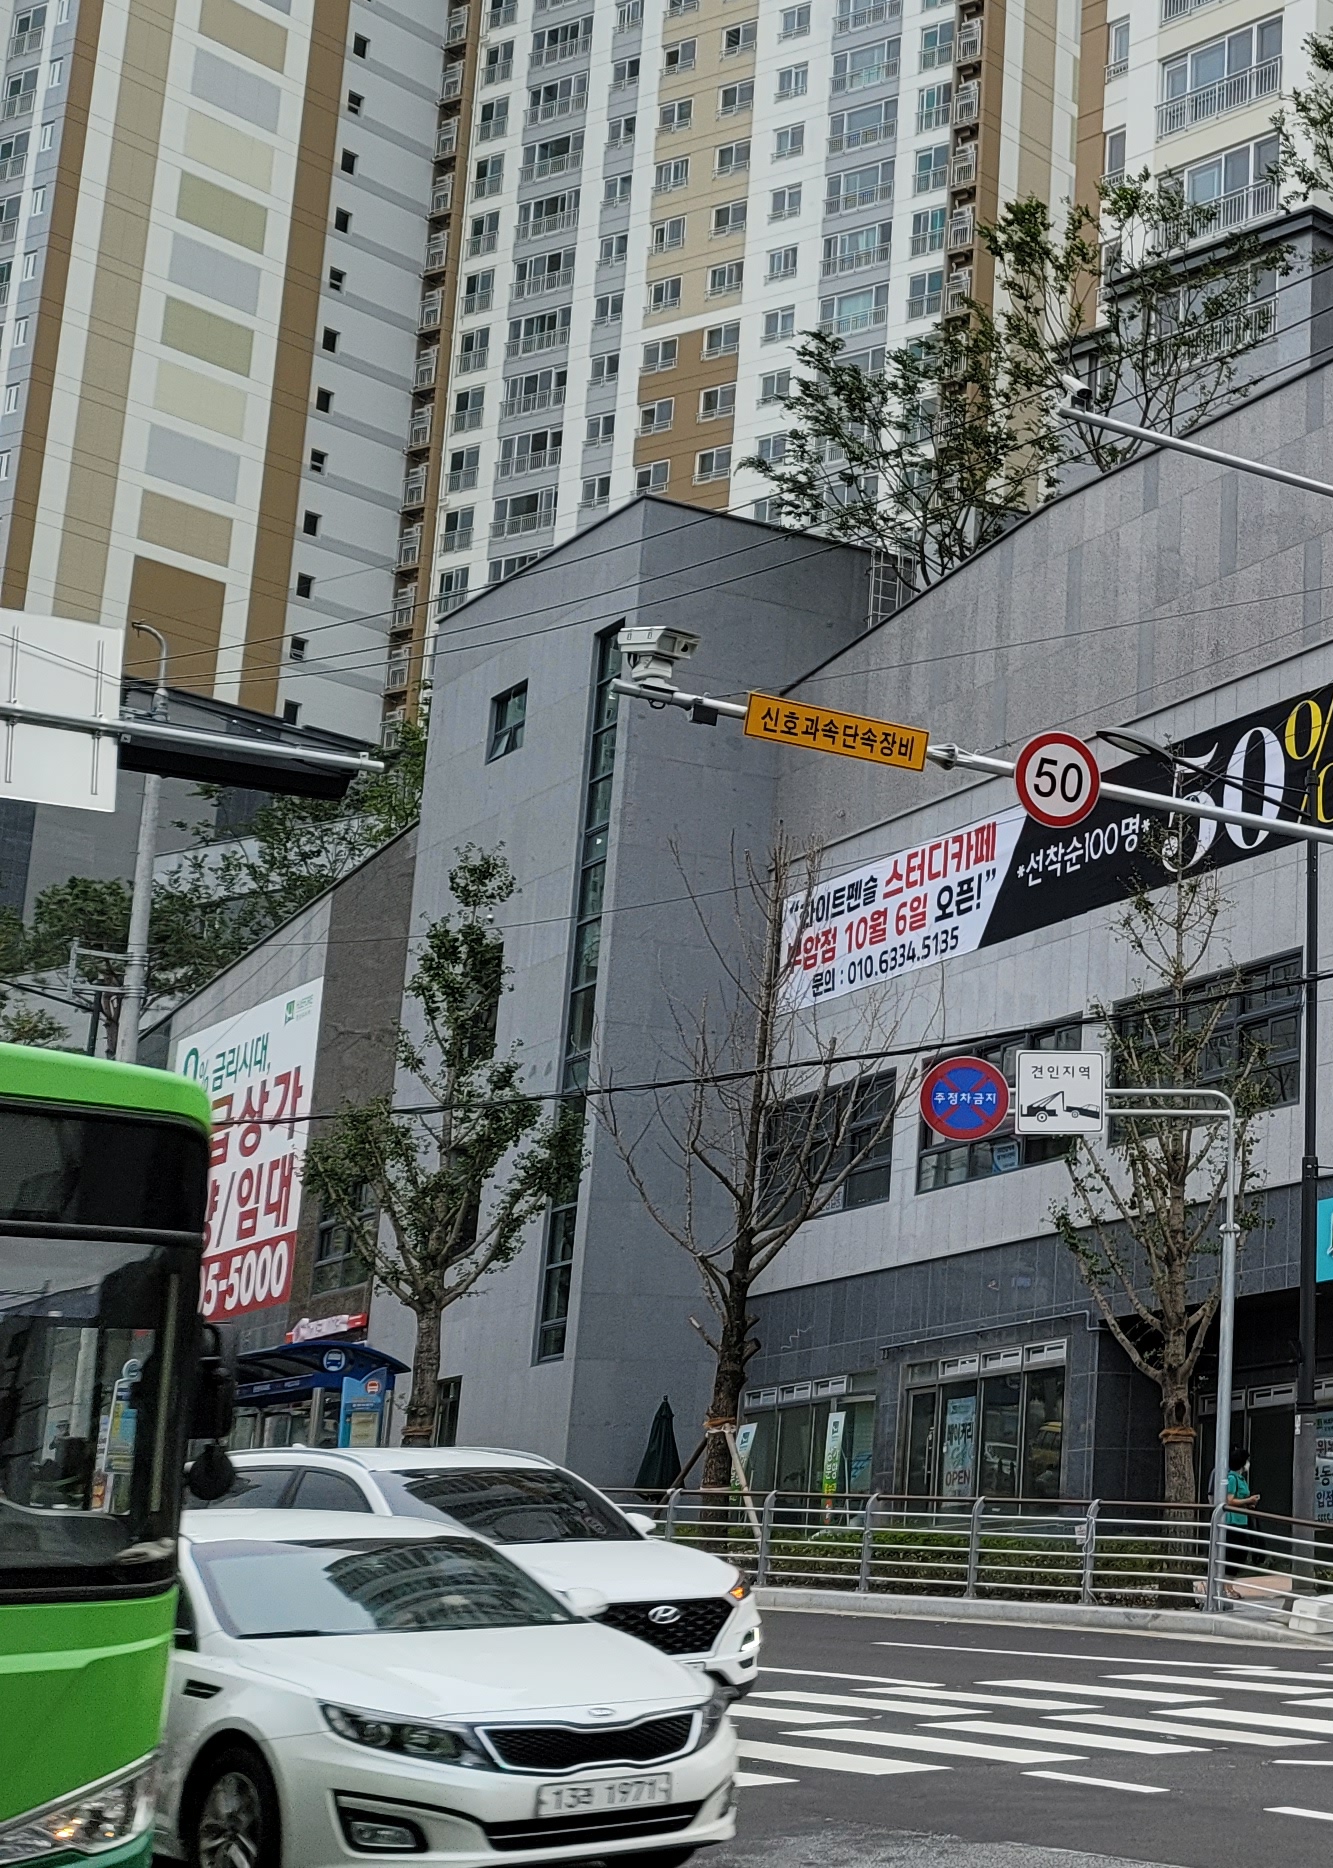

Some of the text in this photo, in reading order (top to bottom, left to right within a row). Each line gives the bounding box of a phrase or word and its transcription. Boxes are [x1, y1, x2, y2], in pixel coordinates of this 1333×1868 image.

[761, 706, 915, 762] 신호과속단속장비
[1033, 756, 1084, 803] 50
[882, 821, 997, 899] 스터디카페
[844, 913, 888, 954] 10월
[894, 891, 929, 937] 6일
[1031, 1065, 1091, 1080] 견인지역
[933, 1091, 997, 1106] 주정차금지
[946, 1470, 971, 1487] OPEN
[604, 1778, 657, 1805] 1971
